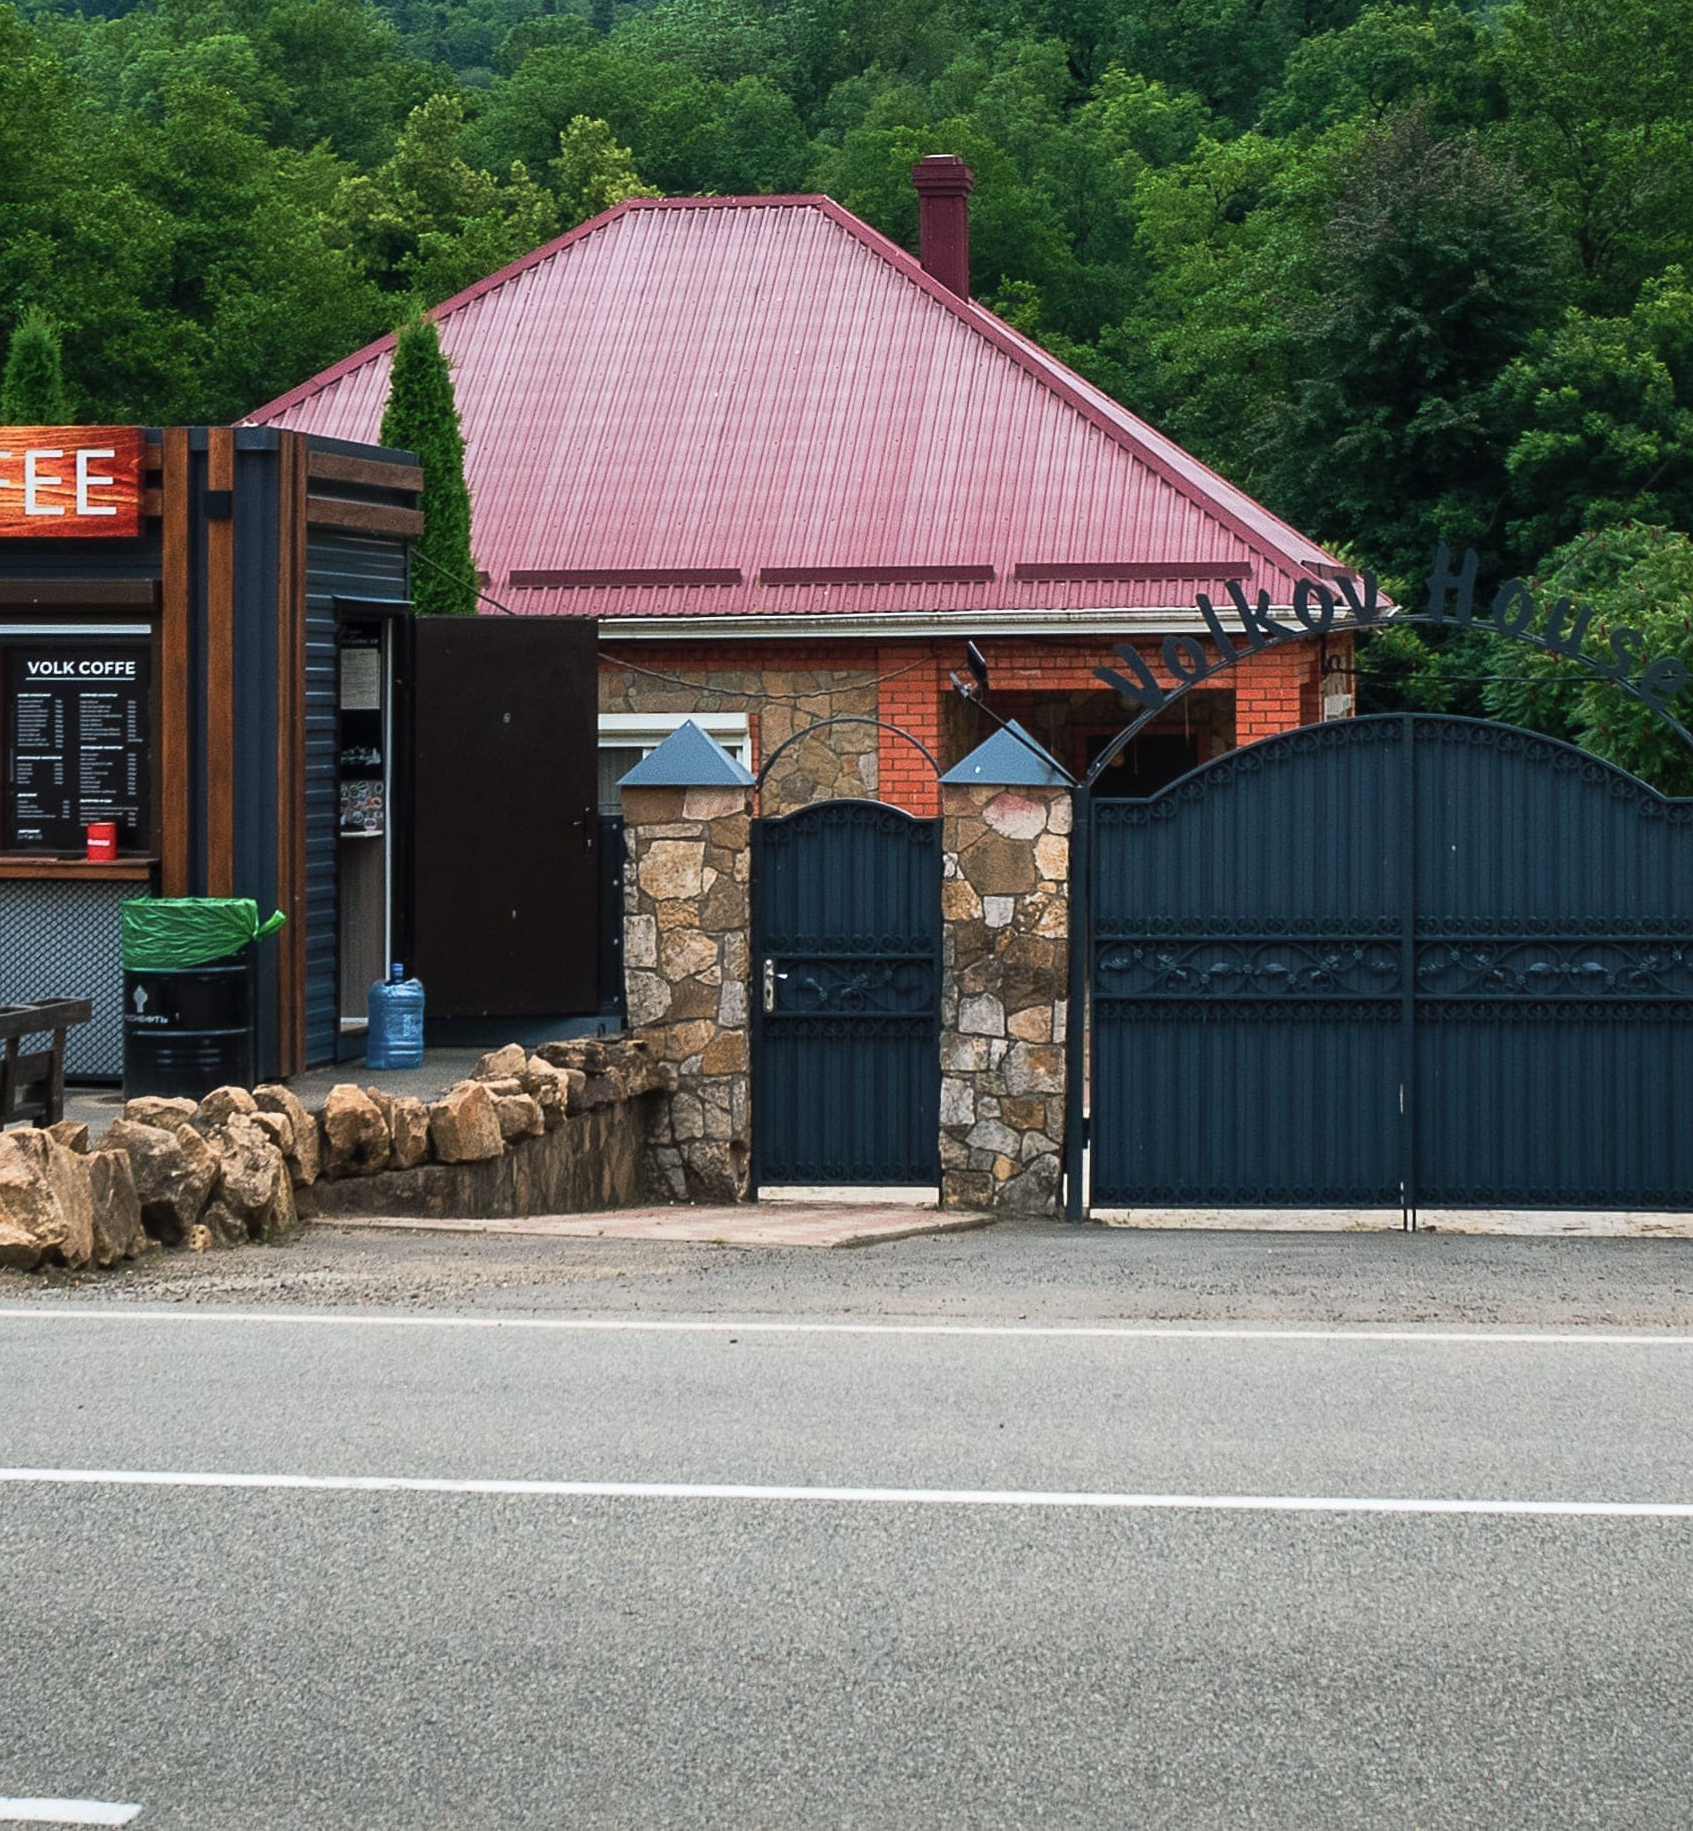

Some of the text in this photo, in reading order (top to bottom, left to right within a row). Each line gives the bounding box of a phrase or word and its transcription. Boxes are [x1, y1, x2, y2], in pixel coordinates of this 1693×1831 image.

[27, 661, 136, 675] VOLK COFFE
[1093, 541, 1686, 711] Volkov House
